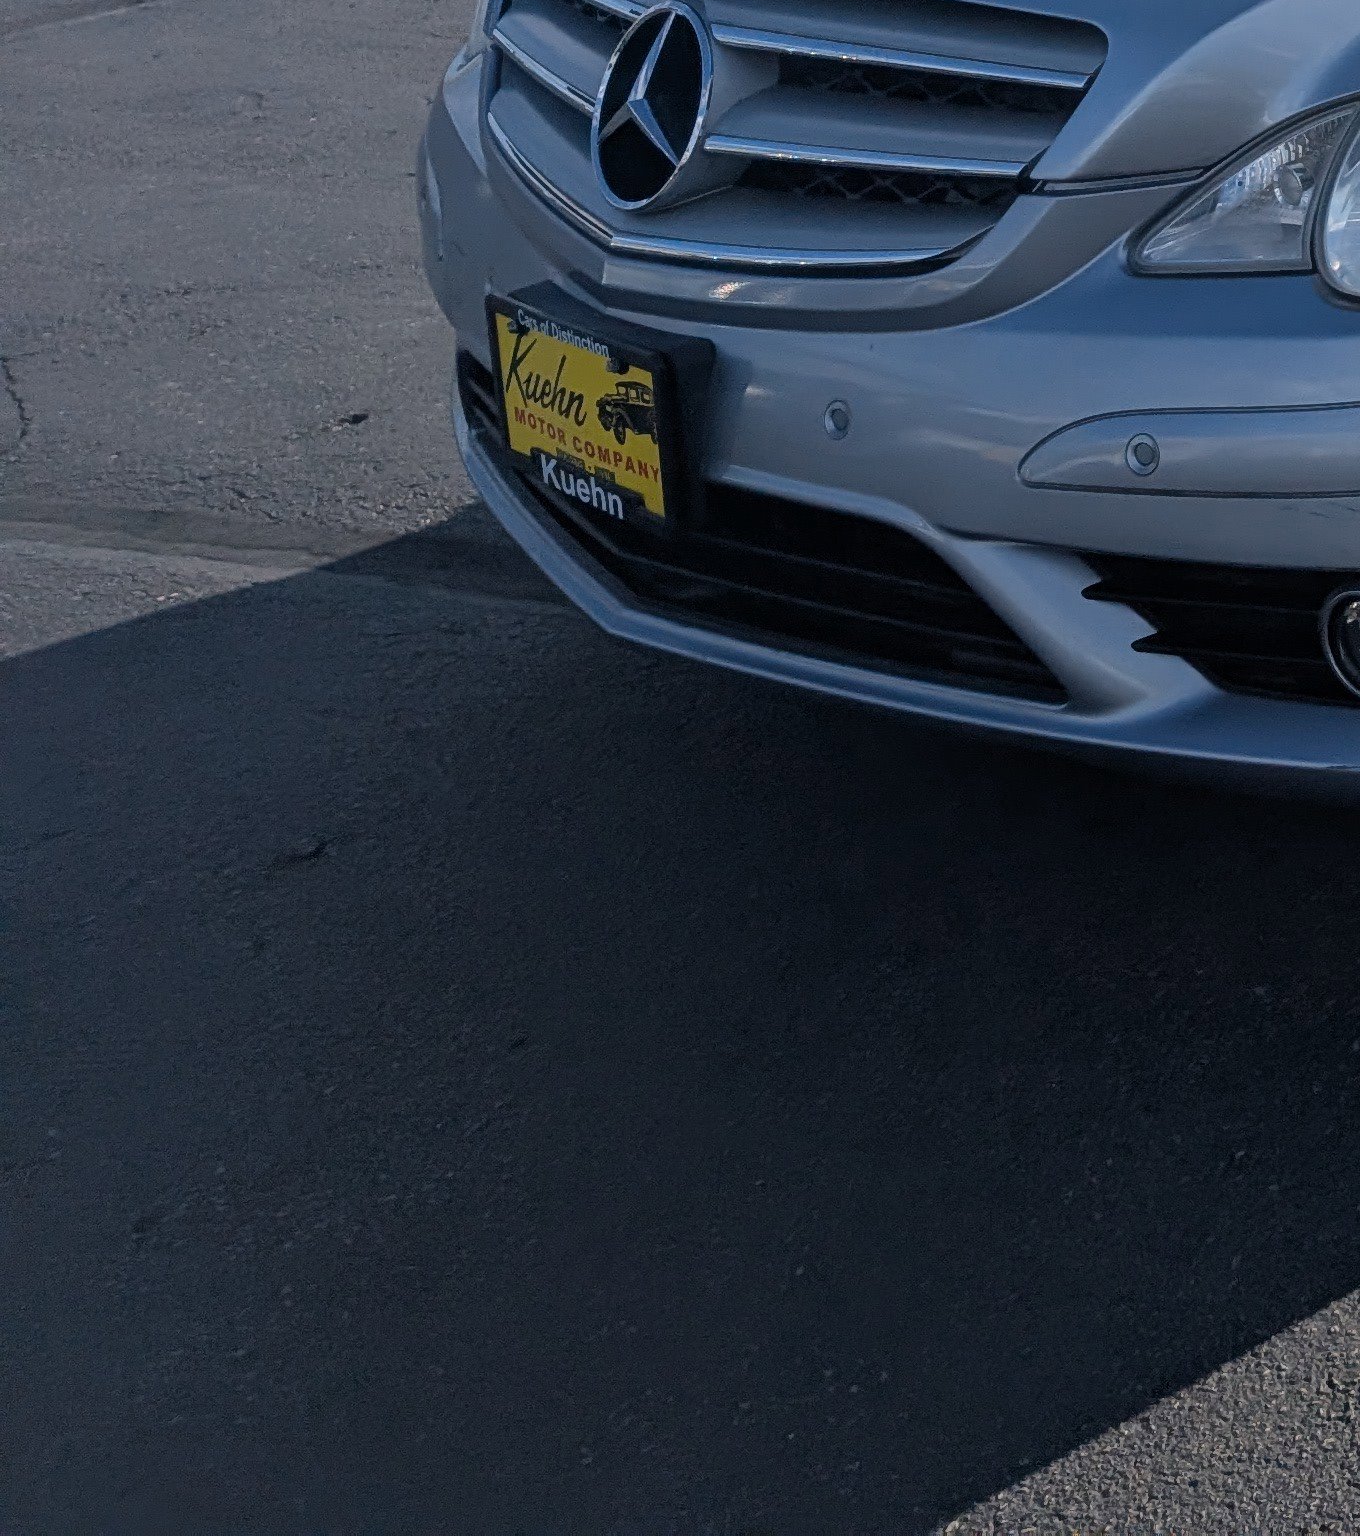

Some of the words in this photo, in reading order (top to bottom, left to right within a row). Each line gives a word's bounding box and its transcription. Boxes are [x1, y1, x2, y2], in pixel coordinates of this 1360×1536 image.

[518, 309, 538, 332] Cars
[551, 322, 611, 360] Distinction
[506, 331, 587, 427] Kuehn
[514, 407, 567, 446] MOTOR
[572, 436, 660, 483] COMPANY
[540, 453, 625, 520] Kuehn
